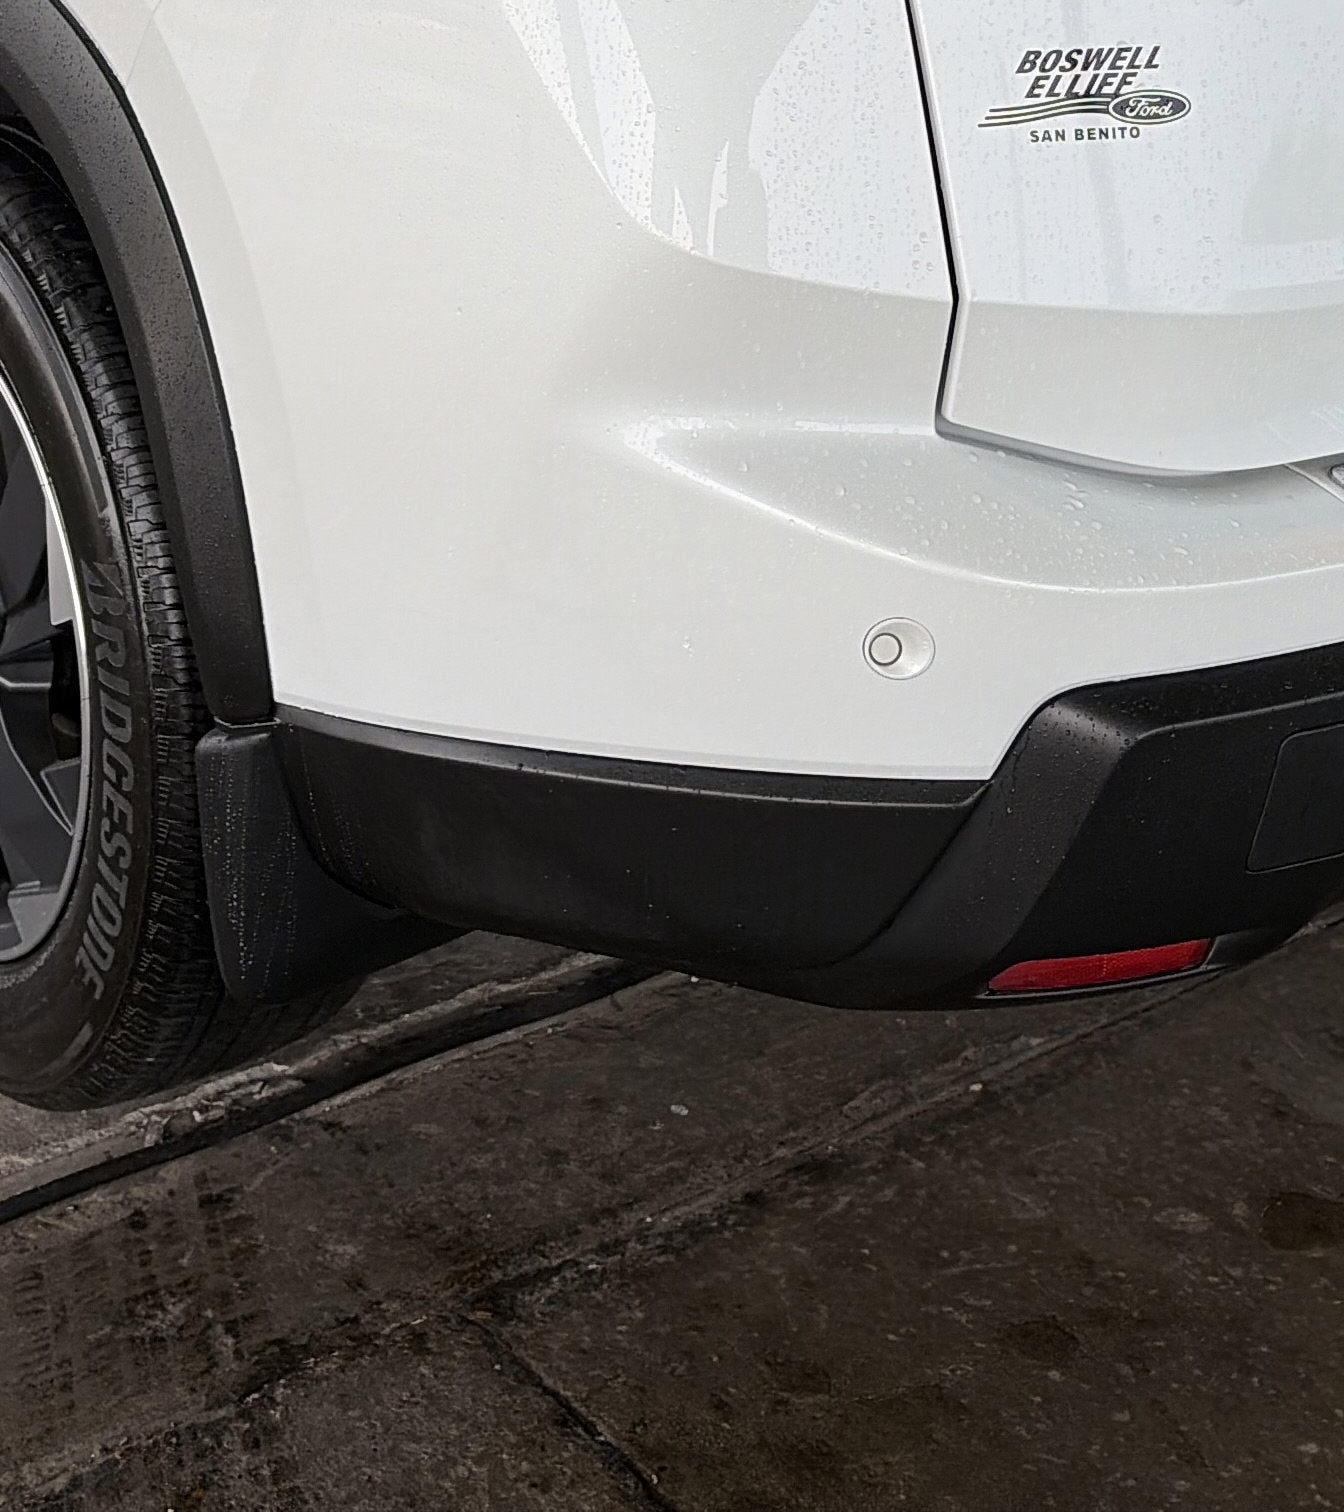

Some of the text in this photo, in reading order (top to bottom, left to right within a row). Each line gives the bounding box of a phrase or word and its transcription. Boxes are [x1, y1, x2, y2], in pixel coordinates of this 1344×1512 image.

[1015, 45, 1161, 74] BOSWELL
[1024, 72, 1138, 98] ELLIFF
[1125, 97, 1173, 117] Ford
[1030, 126, 1141, 143] SAN BENITO
[75, 559, 134, 1000] BRIDGESTONE
